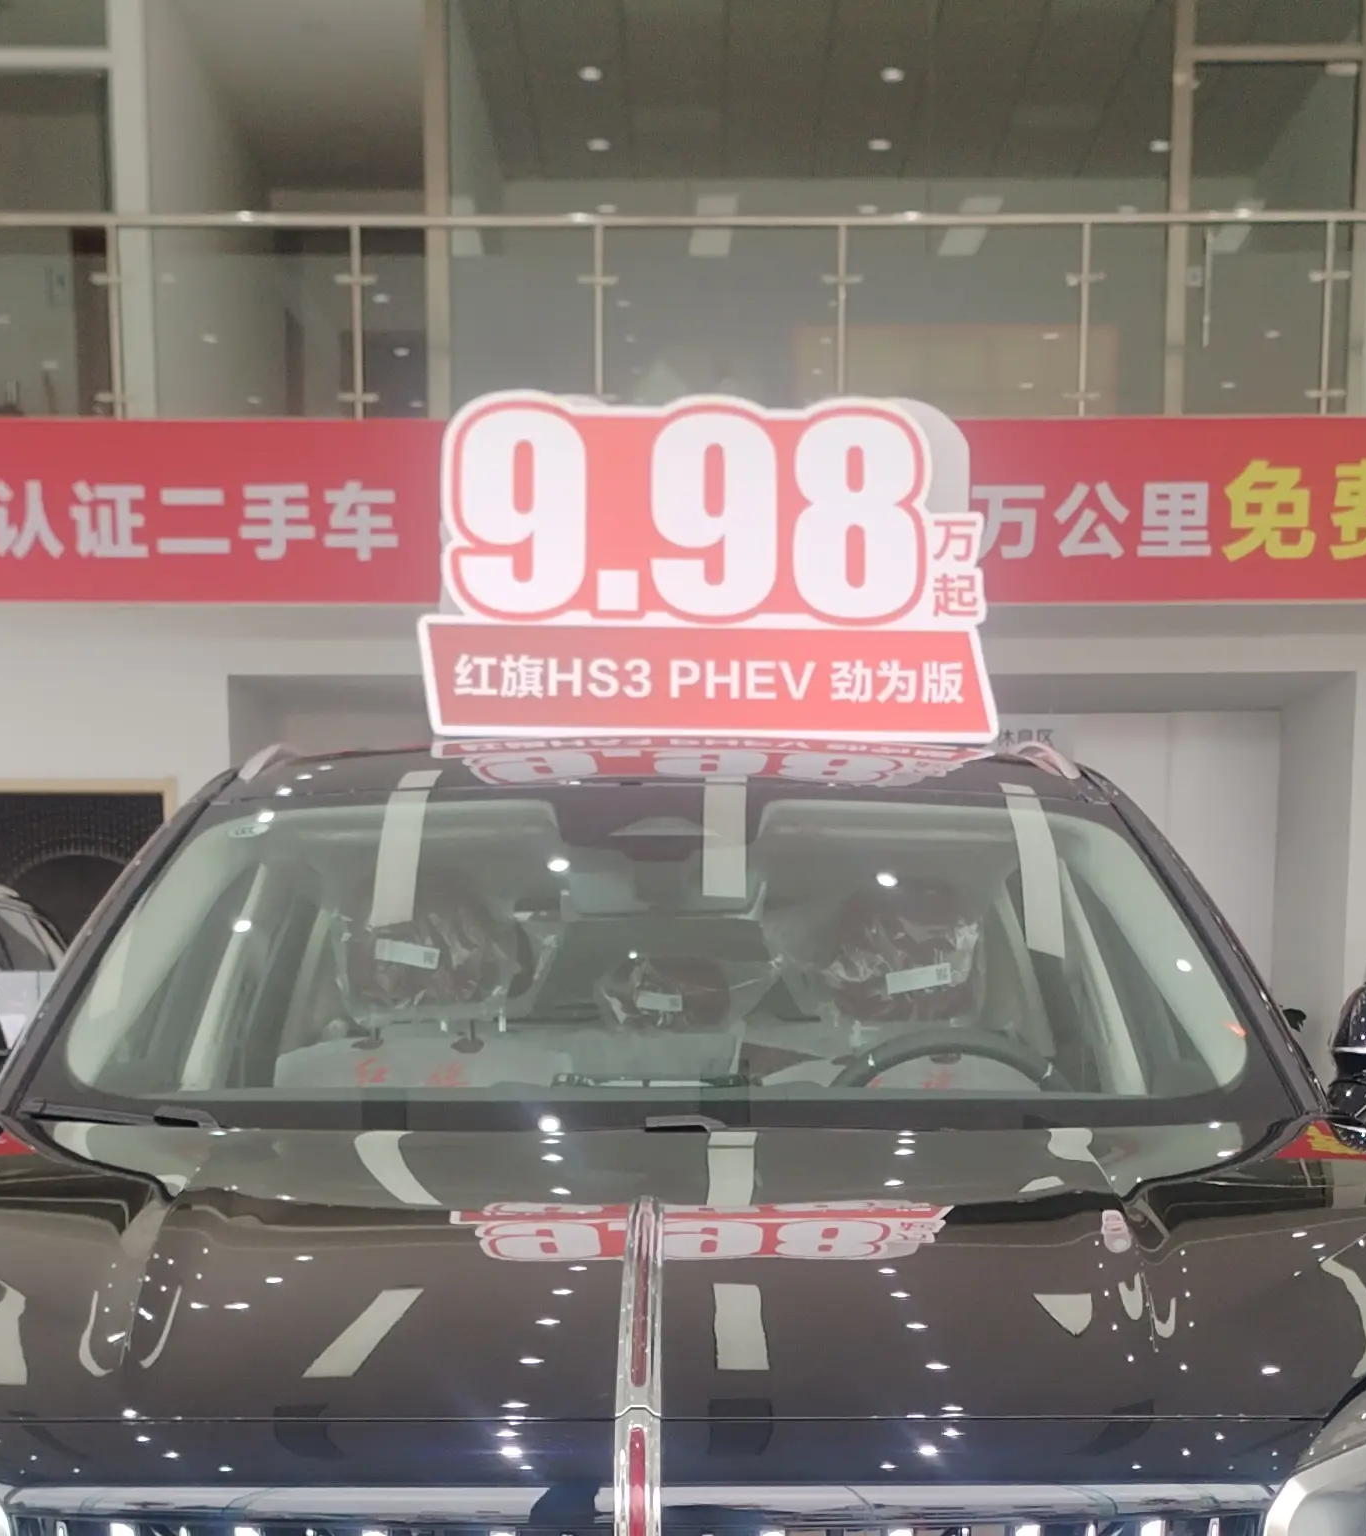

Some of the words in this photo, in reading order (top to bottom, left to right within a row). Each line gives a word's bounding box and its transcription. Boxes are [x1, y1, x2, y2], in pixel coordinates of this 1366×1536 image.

[458, 412, 917, 618] 9.98
[933, 520, 977, 617] 万起
[453, 653, 653, 700] 红旗HS3
[668, 661, 816, 701] PHEV
[829, 660, 964, 705] 劲为版
